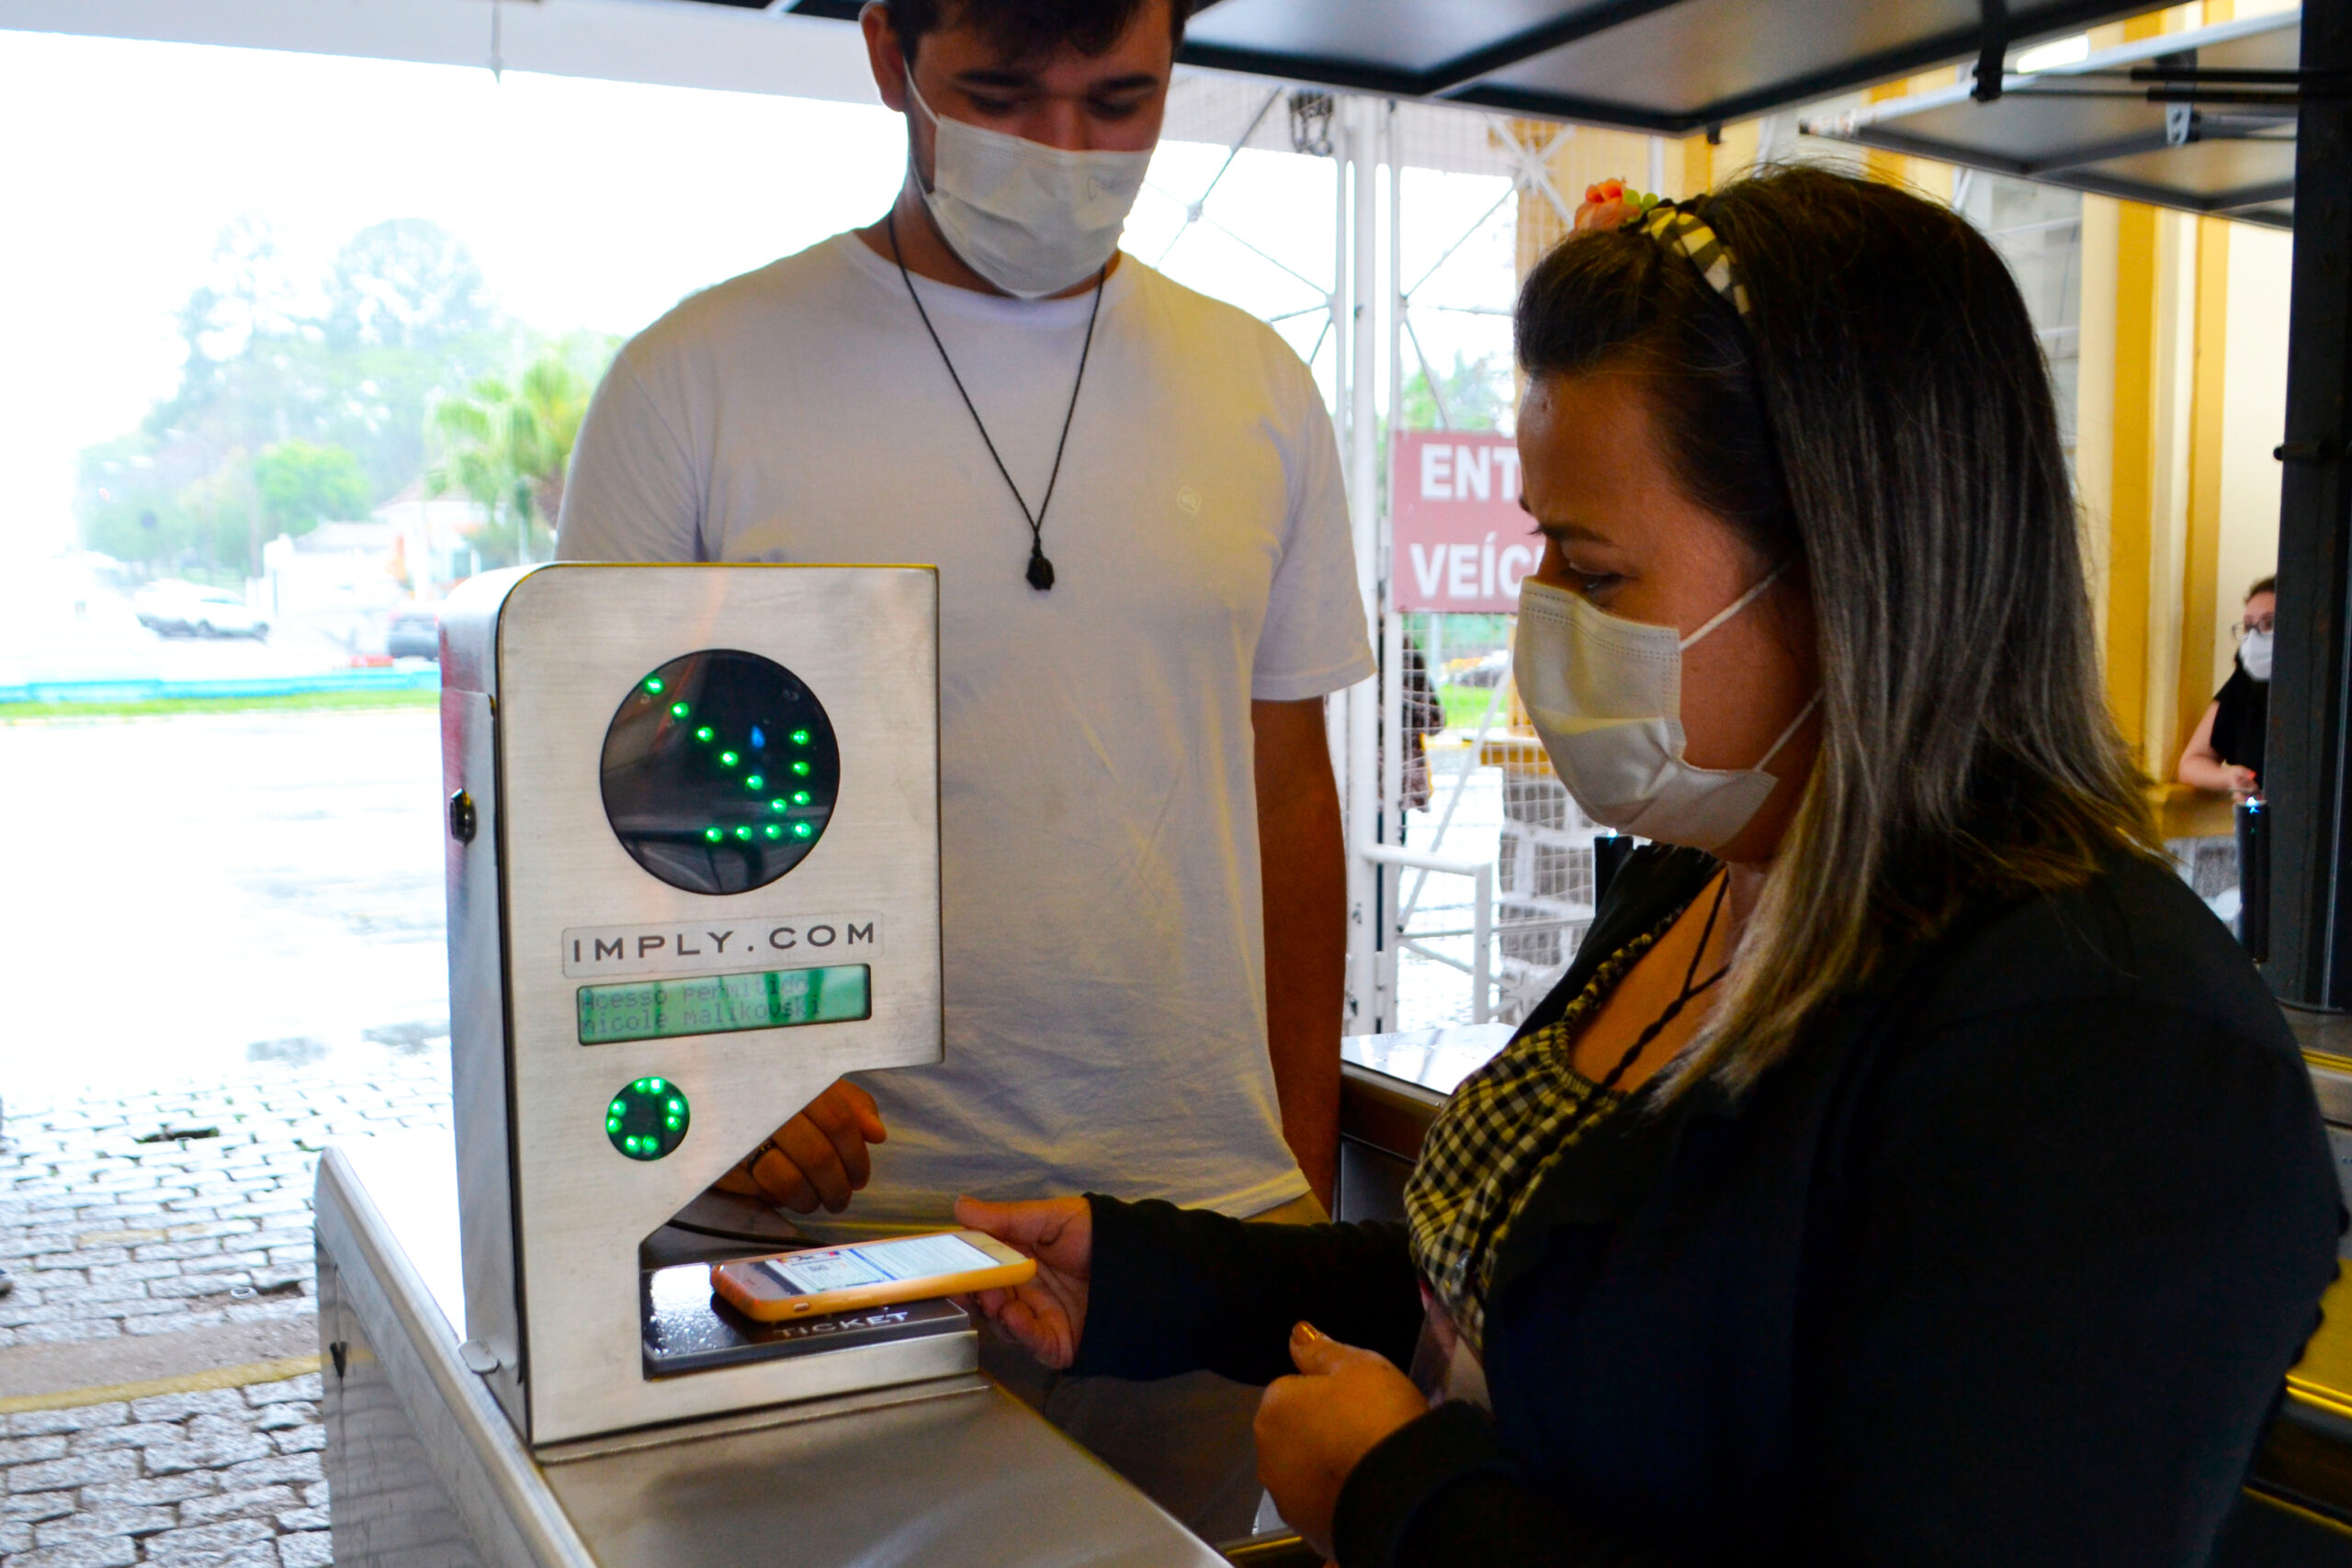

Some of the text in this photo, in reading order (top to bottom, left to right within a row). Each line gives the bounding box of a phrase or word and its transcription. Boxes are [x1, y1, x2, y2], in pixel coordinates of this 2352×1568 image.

[573, 922, 874, 963] IMPLY.COM
[581, 987, 668, 1010] Acesso
[582, 1009, 669, 1034] nicole
[774, 1311, 908, 1337] TICKET
